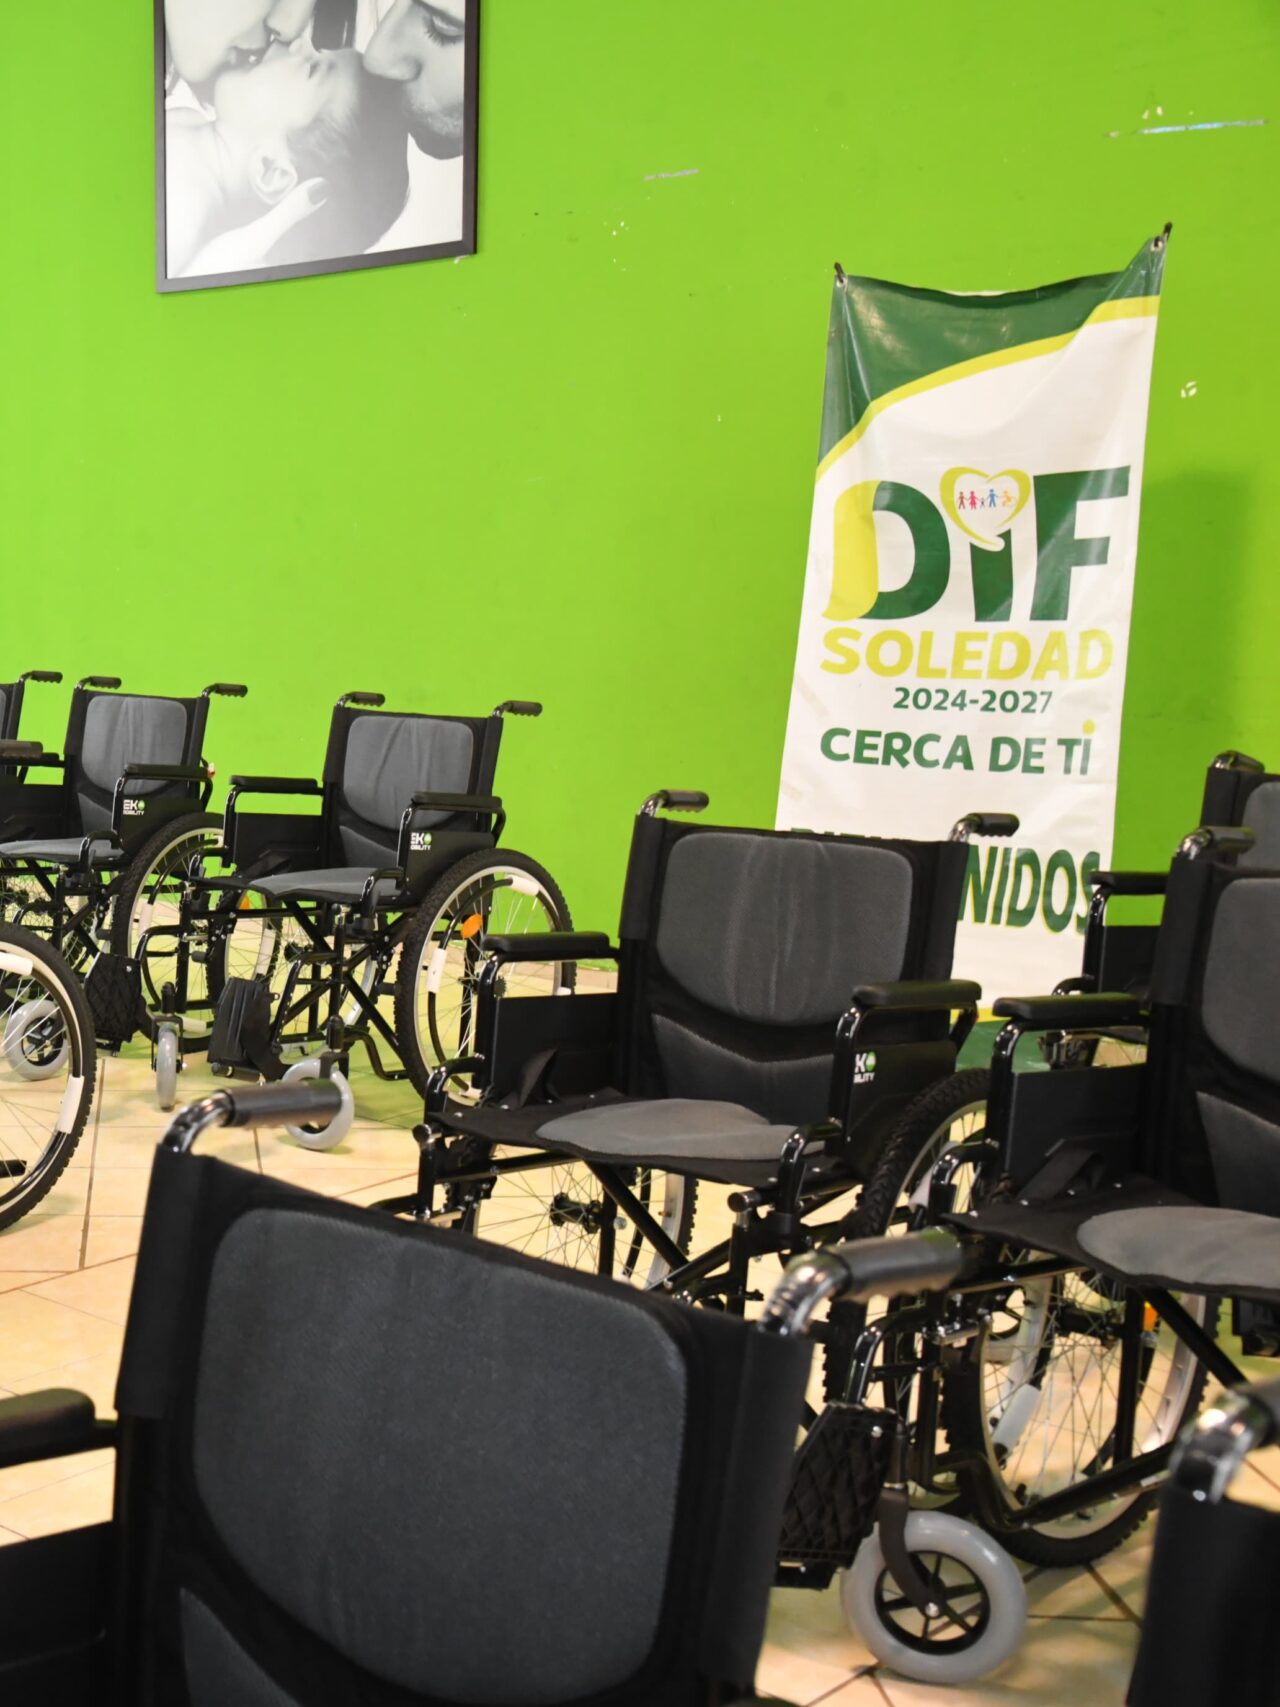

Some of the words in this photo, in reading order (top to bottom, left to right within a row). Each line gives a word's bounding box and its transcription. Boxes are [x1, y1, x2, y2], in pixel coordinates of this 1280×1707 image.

[820, 627, 1113, 681] SOLEDAD
[893, 687, 1053, 714] 2024-2027
[820, 727, 974, 770] CERCA
[988, 736, 1047, 774] DE
